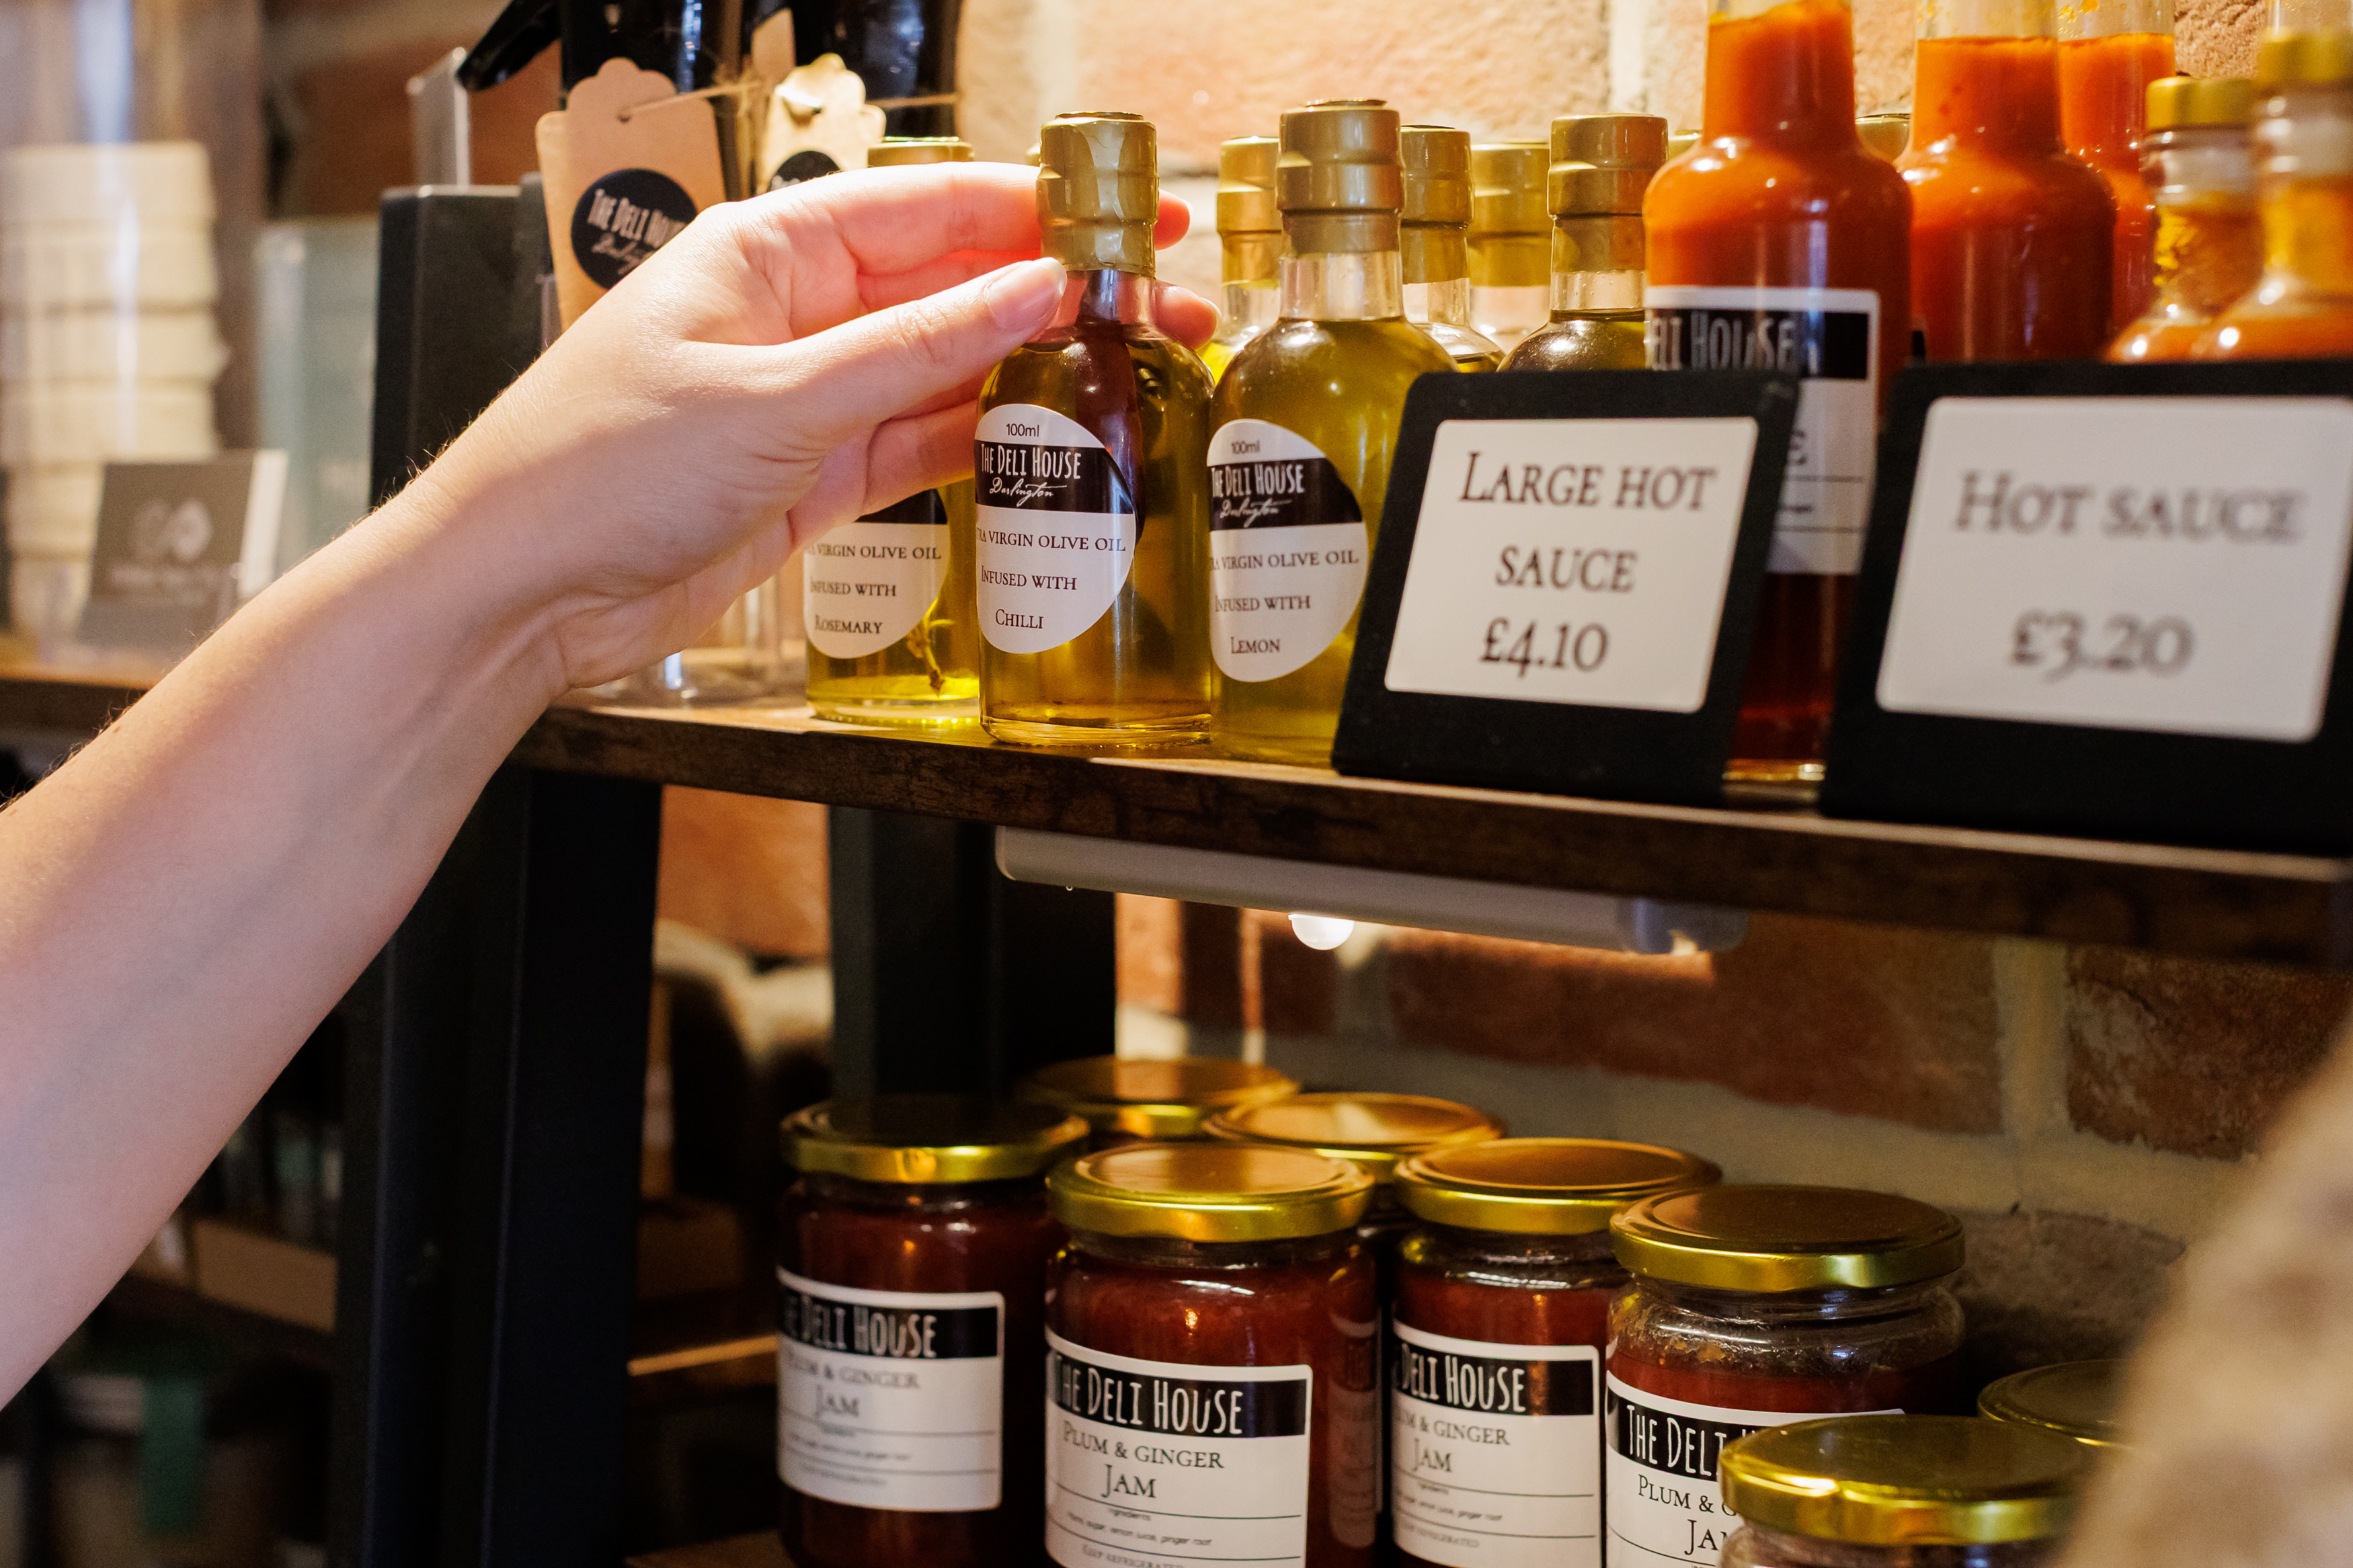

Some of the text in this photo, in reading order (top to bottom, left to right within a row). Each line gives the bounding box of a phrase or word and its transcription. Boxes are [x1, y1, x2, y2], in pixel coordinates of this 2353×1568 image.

[1006, 423, 1039, 438] 100ml
[981, 443, 1082, 479] THE DELI HOUSE
[989, 477, 1068, 507] Darlington
[1224, 464, 1252, 497] DELI
[1254, 462, 1305, 495] HOUSE
[1458, 451, 1718, 512] LARGE HOT
[1954, 471, 2307, 546] HOT SAUCE
[860, 545, 907, 559] OLIVE
[912, 546, 942, 560] OIL
[988, 530, 1033, 547] VIRGIN
[1038, 535, 1089, 550] OLIVE
[1094, 538, 1126, 552] OIL
[982, 565, 1077, 590] INFUSED WITH
[1222, 554, 1263, 571] VIRGIN
[1268, 552, 1320, 568] OLIVE
[1325, 549, 1359, 565] OIL
[1494, 545, 1638, 593] SAUCE
[855, 583, 897, 597] WITH
[1215, 595, 1310, 612] INFUSED WITH
[814, 614, 883, 634] ROSEMARY
[996, 608, 1044, 629] CHILLI
[1231, 636, 1281, 654] LEMON
[1478, 617, 1609, 679] £4.10
[2009, 608, 2196, 684] £3.20
[852, 1303, 937, 1358] HOUSE
[1401, 1342, 1526, 1412] DELI HOUSE
[1086, 1367, 1144, 1426] DELI
[1153, 1380, 1244, 1435] HOUSE
[1062, 1419, 1225, 1469] PLUM & GINGER
[1433, 1419, 1511, 1445] GINGER
[1626, 1404, 1659, 1465] THE
[1412, 1437, 1453, 1473] JAM
[1101, 1463, 1157, 1498] JAM
[1638, 1473, 1691, 1510] PLUM
[1698, 1494, 1715, 1514] &
[1683, 1518, 1729, 1556] JA
